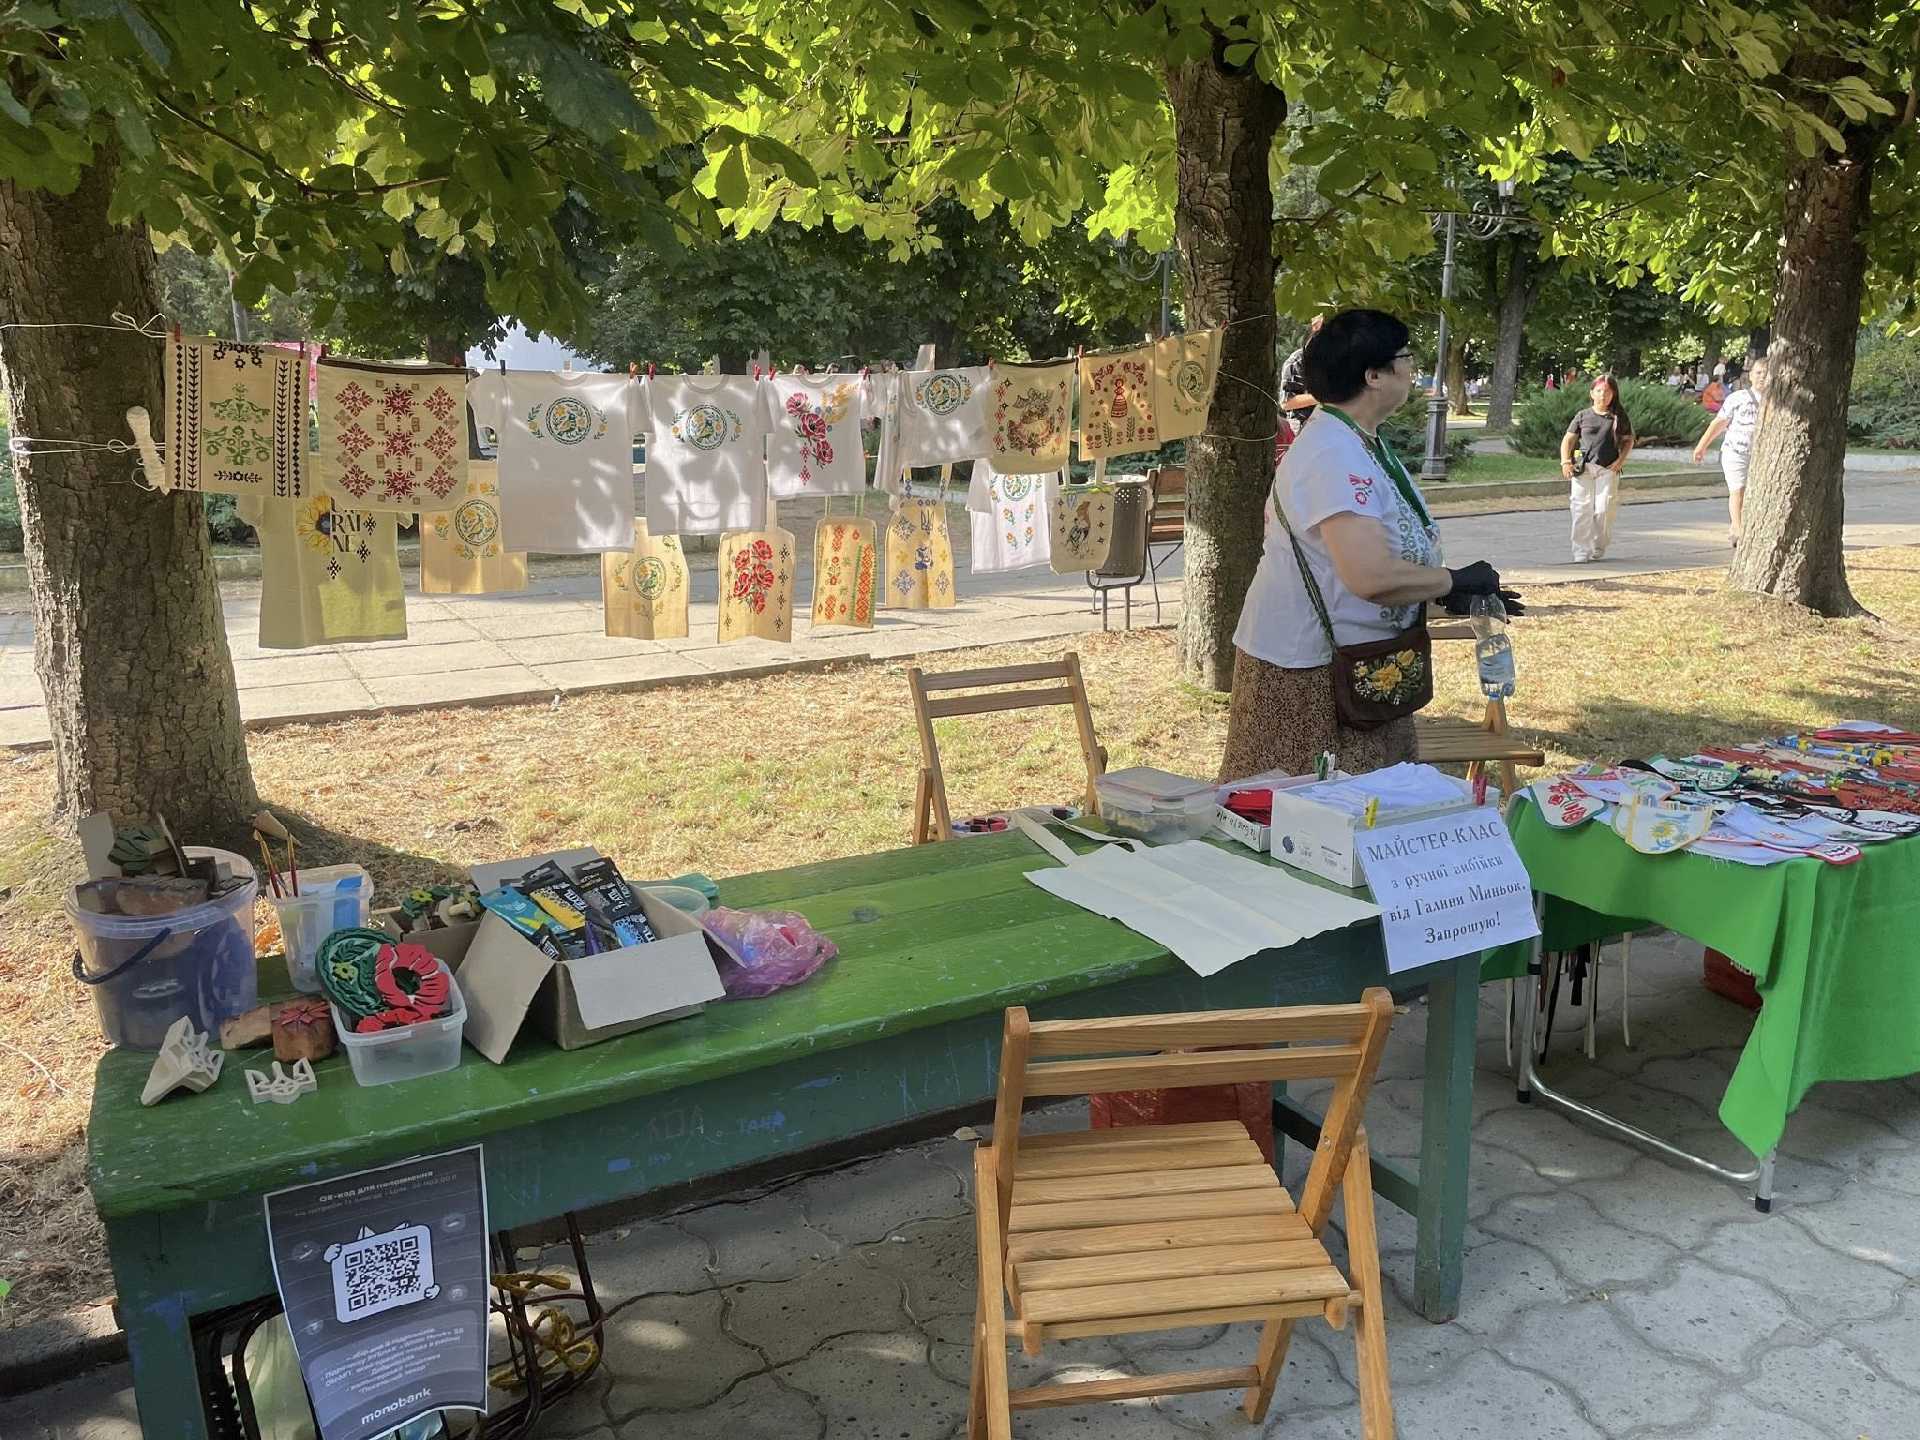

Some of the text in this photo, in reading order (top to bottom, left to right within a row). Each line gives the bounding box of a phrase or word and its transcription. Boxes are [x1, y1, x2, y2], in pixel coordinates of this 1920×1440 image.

[1367, 821, 1502, 863] МАЙСТЕР-КЛАС
[1404, 863, 1450, 891] ручної
[1389, 906, 1411, 923] від
[1414, 894, 1465, 916] Галини
[1424, 911, 1502, 944] Запрошую!
[360, 1386, 432, 1425] monobank
